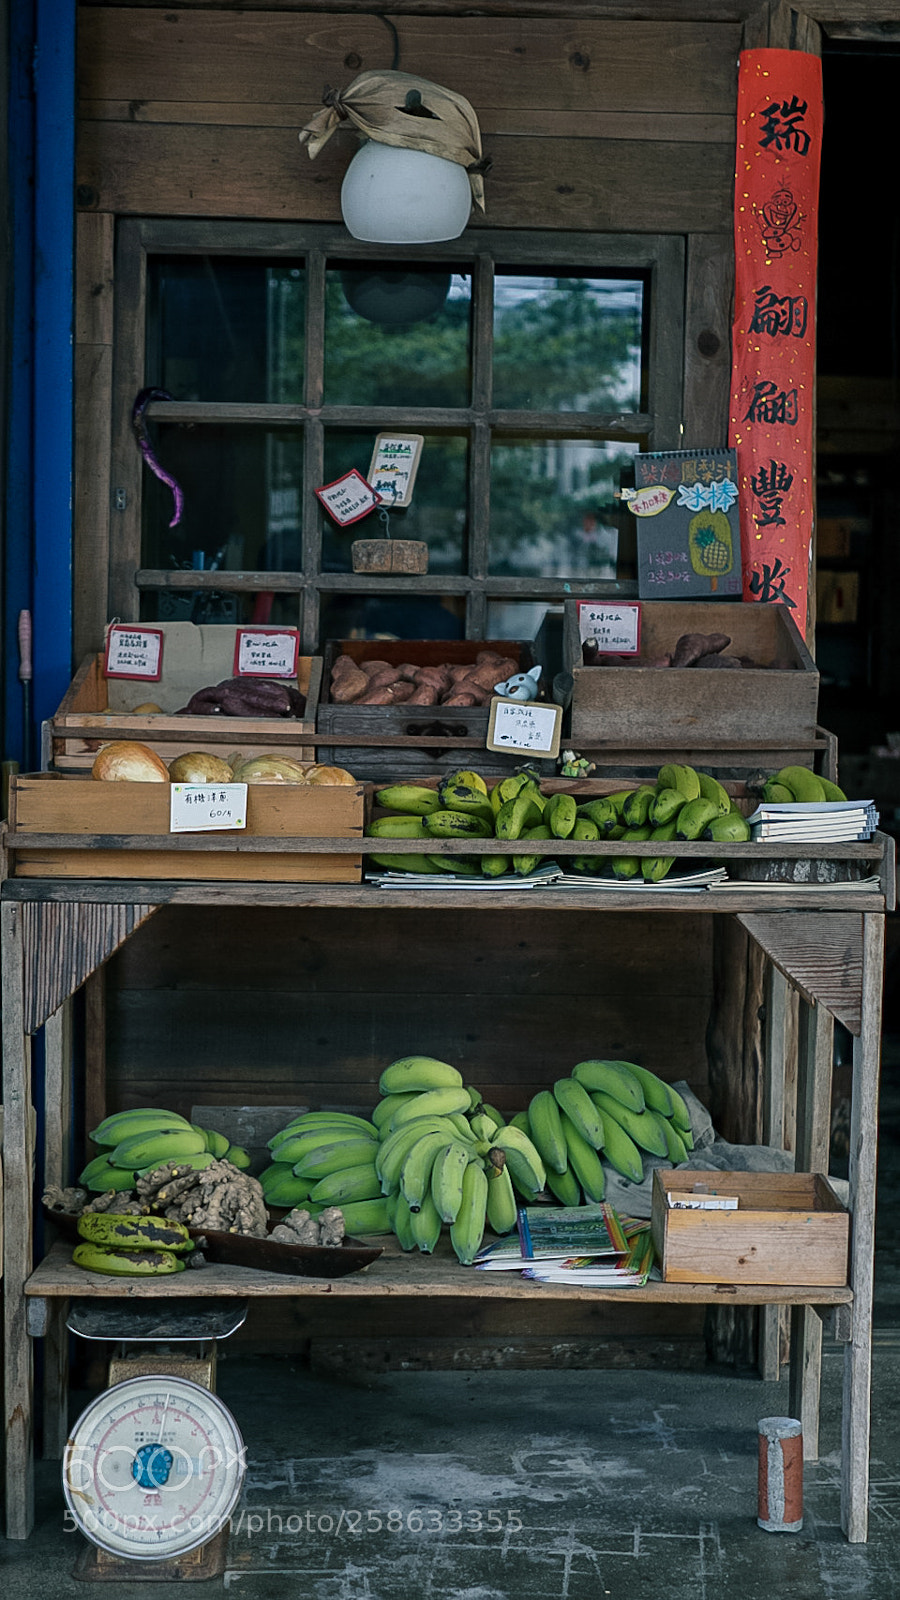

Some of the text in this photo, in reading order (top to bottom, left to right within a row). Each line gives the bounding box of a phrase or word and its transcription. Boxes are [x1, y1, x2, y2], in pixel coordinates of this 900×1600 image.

[678, 478, 738, 512] 冰棒
[184, 792, 227, 804] 有機洋蔥
